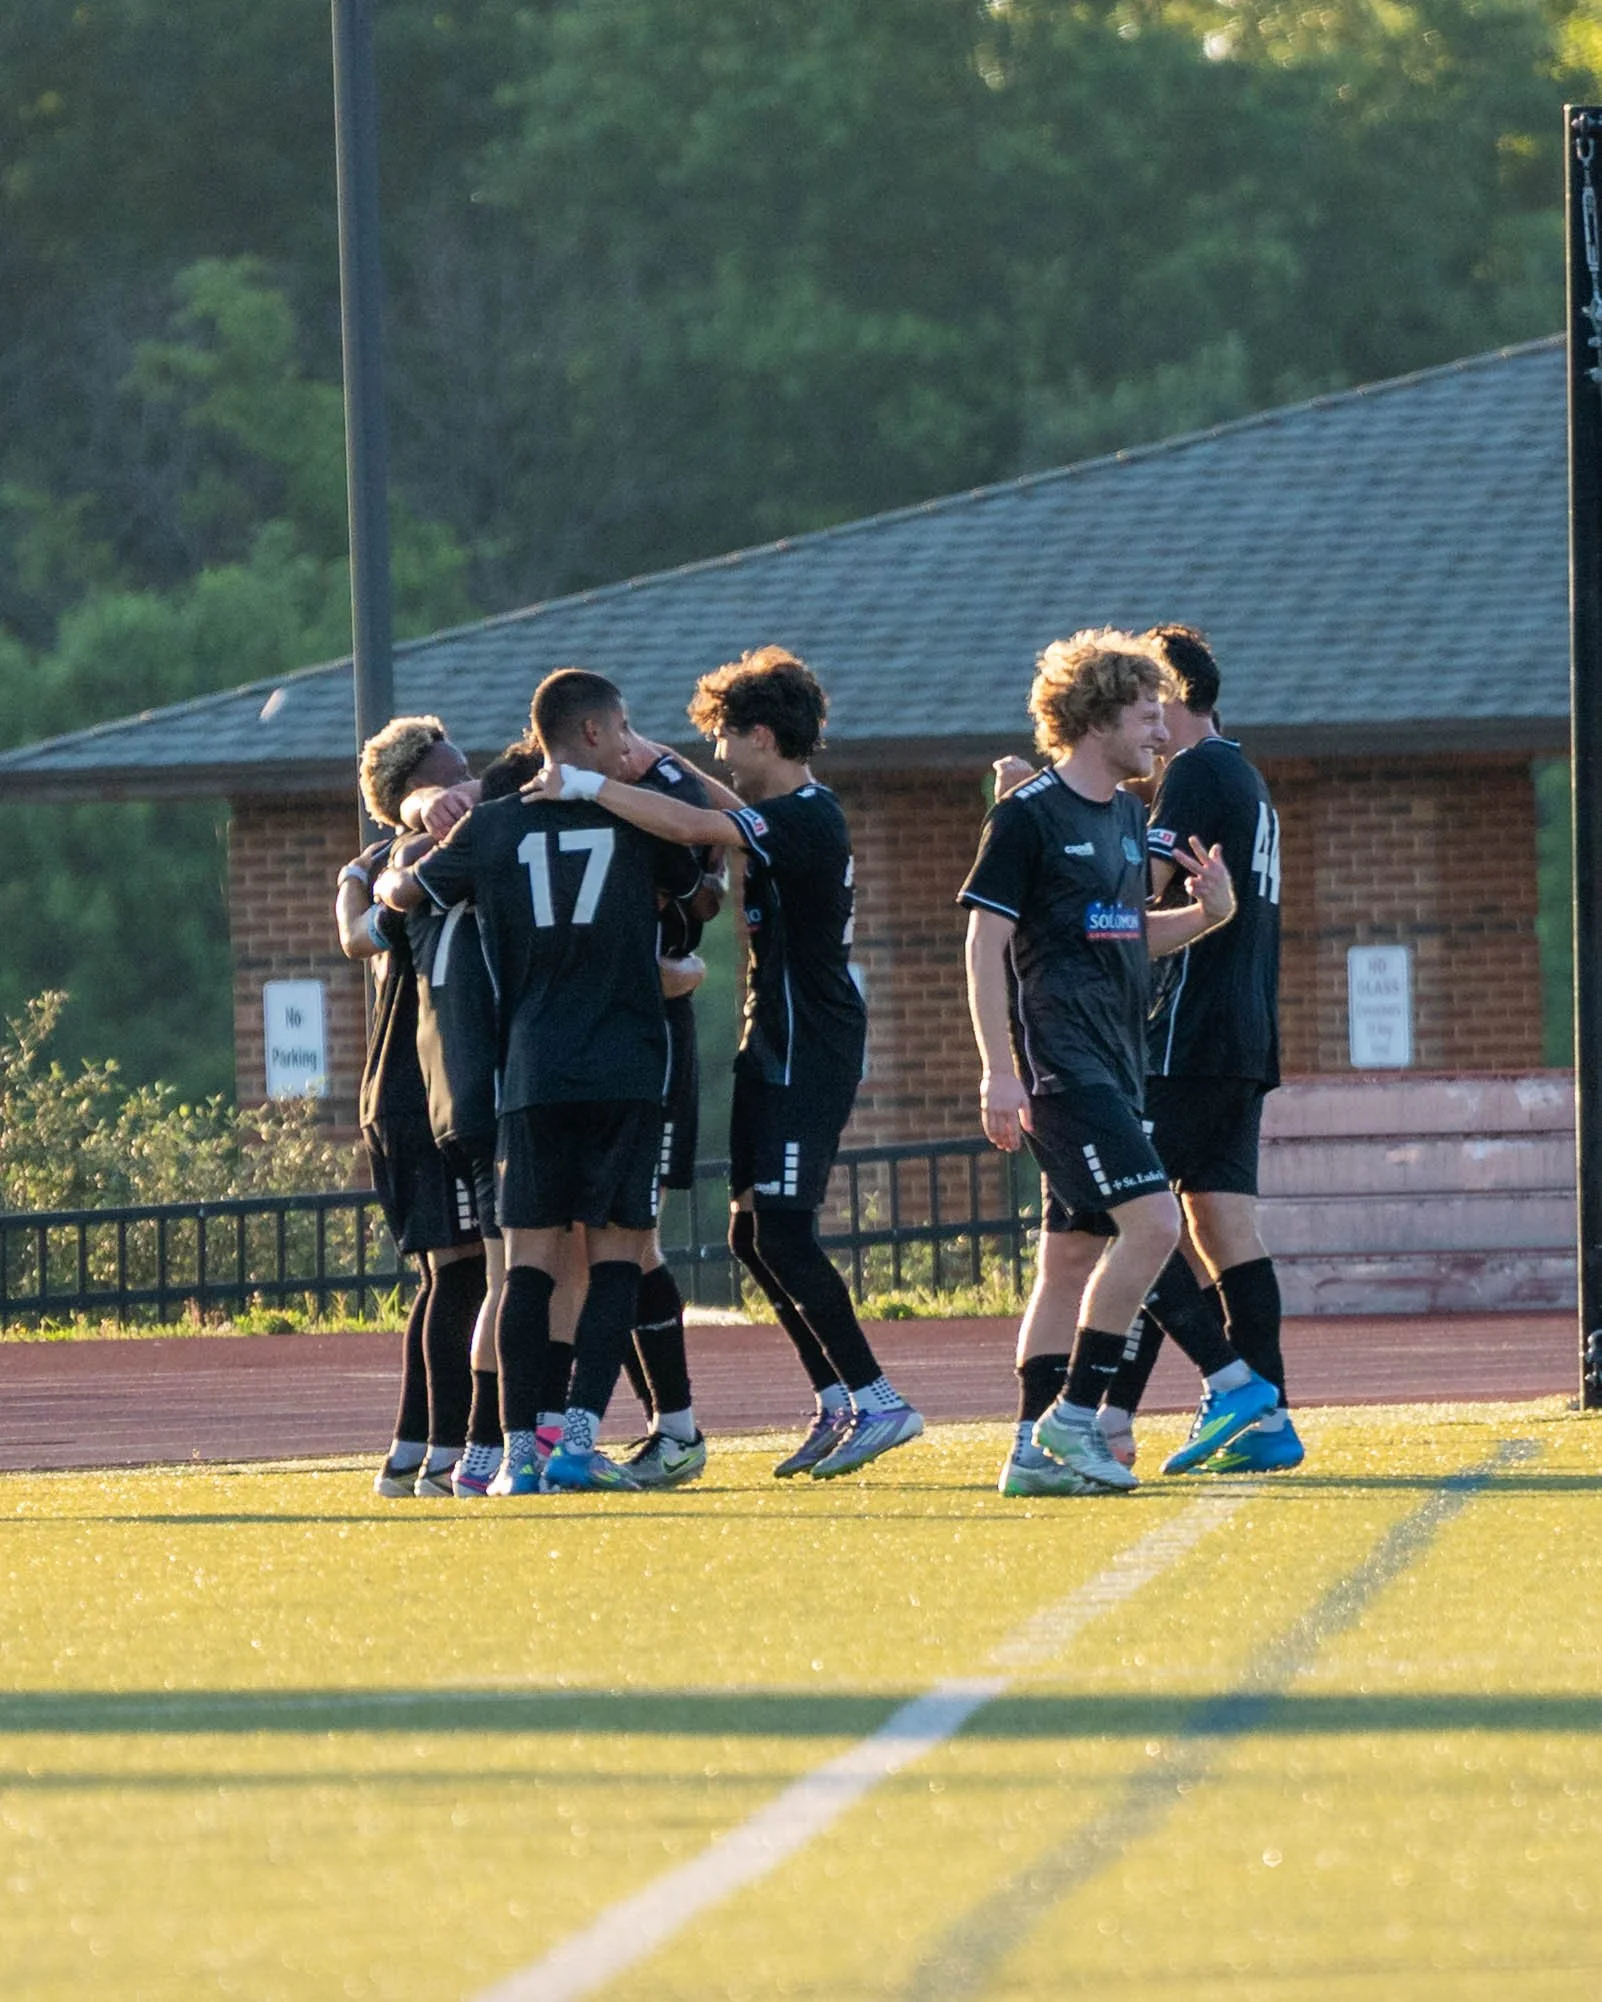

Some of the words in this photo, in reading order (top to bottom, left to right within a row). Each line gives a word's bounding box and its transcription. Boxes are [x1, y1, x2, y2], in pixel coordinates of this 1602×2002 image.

[517, 827, 615, 928] 17
[1089, 912, 1139, 930] SOLOMON
[284, 1006, 303, 1028] No
[271, 1047, 317, 1072] Parking
